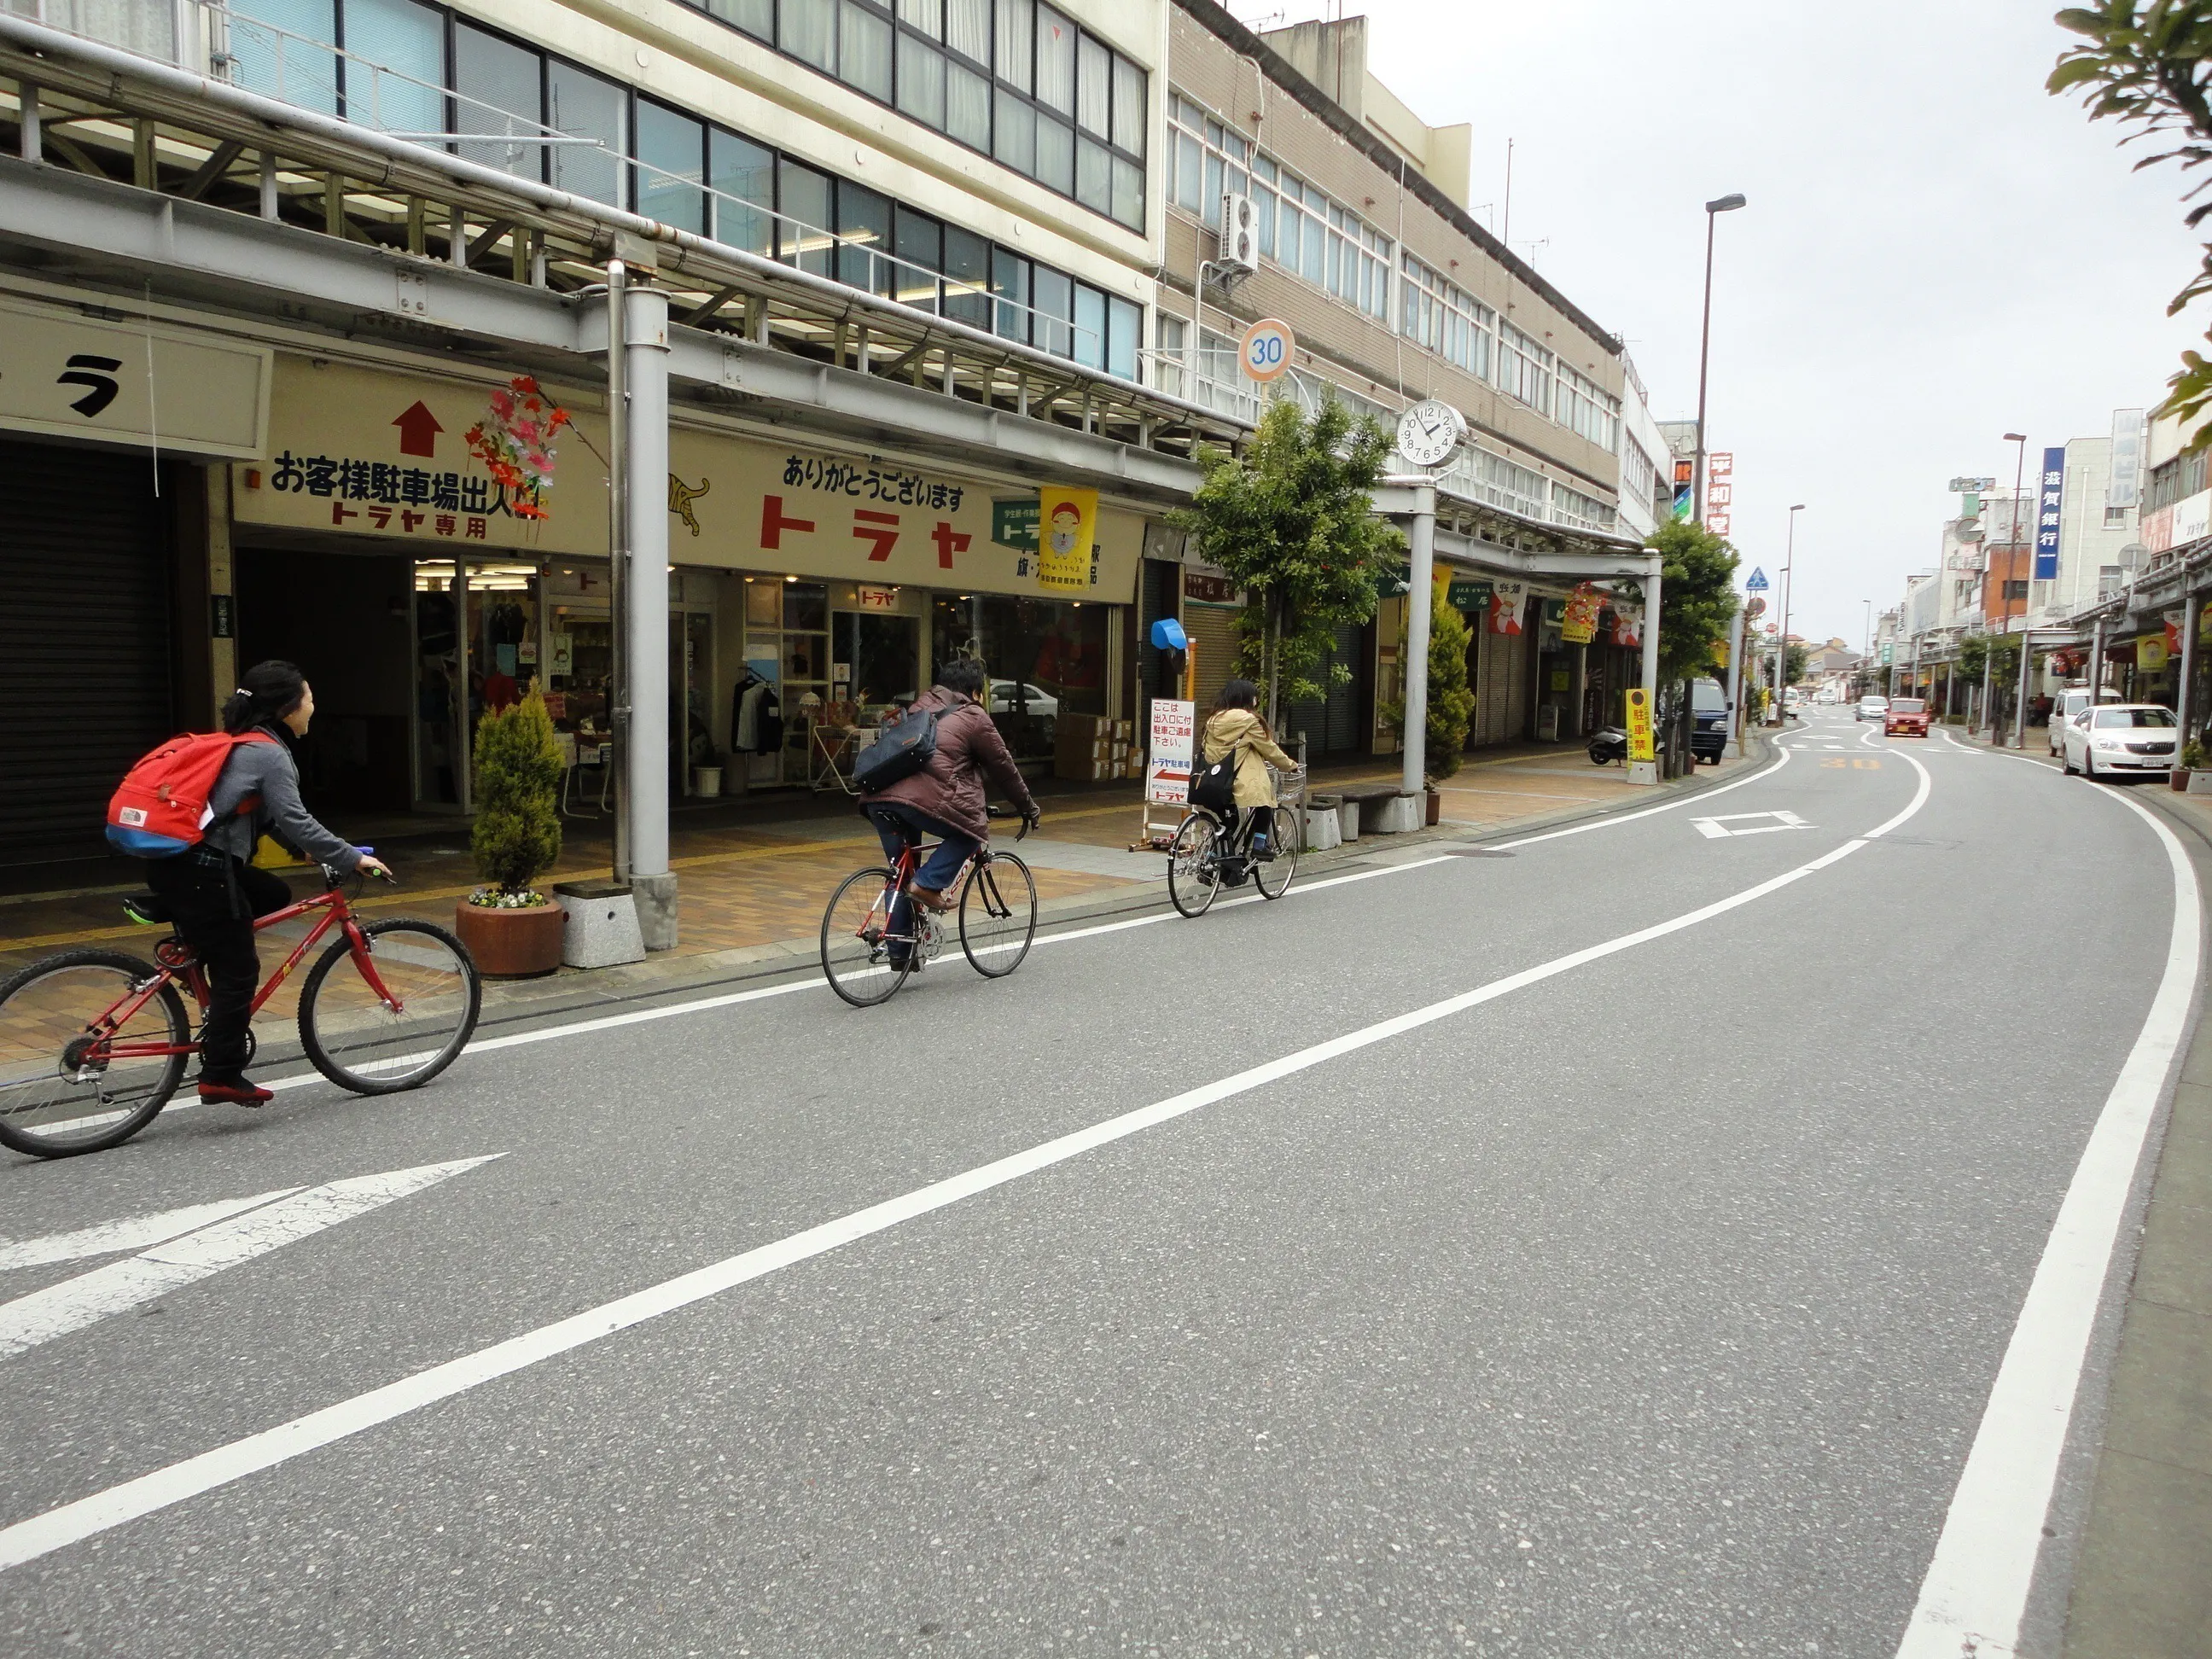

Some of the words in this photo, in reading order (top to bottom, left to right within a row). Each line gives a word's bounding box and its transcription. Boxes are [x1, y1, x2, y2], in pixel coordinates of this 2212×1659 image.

[1251, 337, 1283, 364] 30
[1425, 407, 1434, 416] 12
[1406, 419, 1416, 428] 10
[1443, 416, 1450, 426] 2
[1404, 430, 1411, 439] 9
[1445, 427, 1452, 436] 3
[1407, 439, 1413, 449] 8
[1441, 438, 1448, 446] 4
[1415, 448, 1421, 457] 7
[1423, 450, 1430, 459] 6
[1434, 446, 1441, 456] 5
[783, 455, 964, 513] ありがとうございます
[1708, 455, 1732, 533] 平和堂
[2039, 471, 2061, 546] 滋賀銀行
[332, 501, 486, 539] トラヤ専用
[760, 494, 972, 569] トラヤ
[862, 591, 895, 607] トラヤ
[1154, 701, 1179, 713] ここは
[1154, 714, 1191, 725] 出入口に付
[1153, 725, 1191, 737] 駐車ご遠慮
[1153, 736, 1182, 748] 下さい。
[1152, 758, 1190, 769] トラヤ駐車場
[1155, 791, 1185, 802] トラヤ
